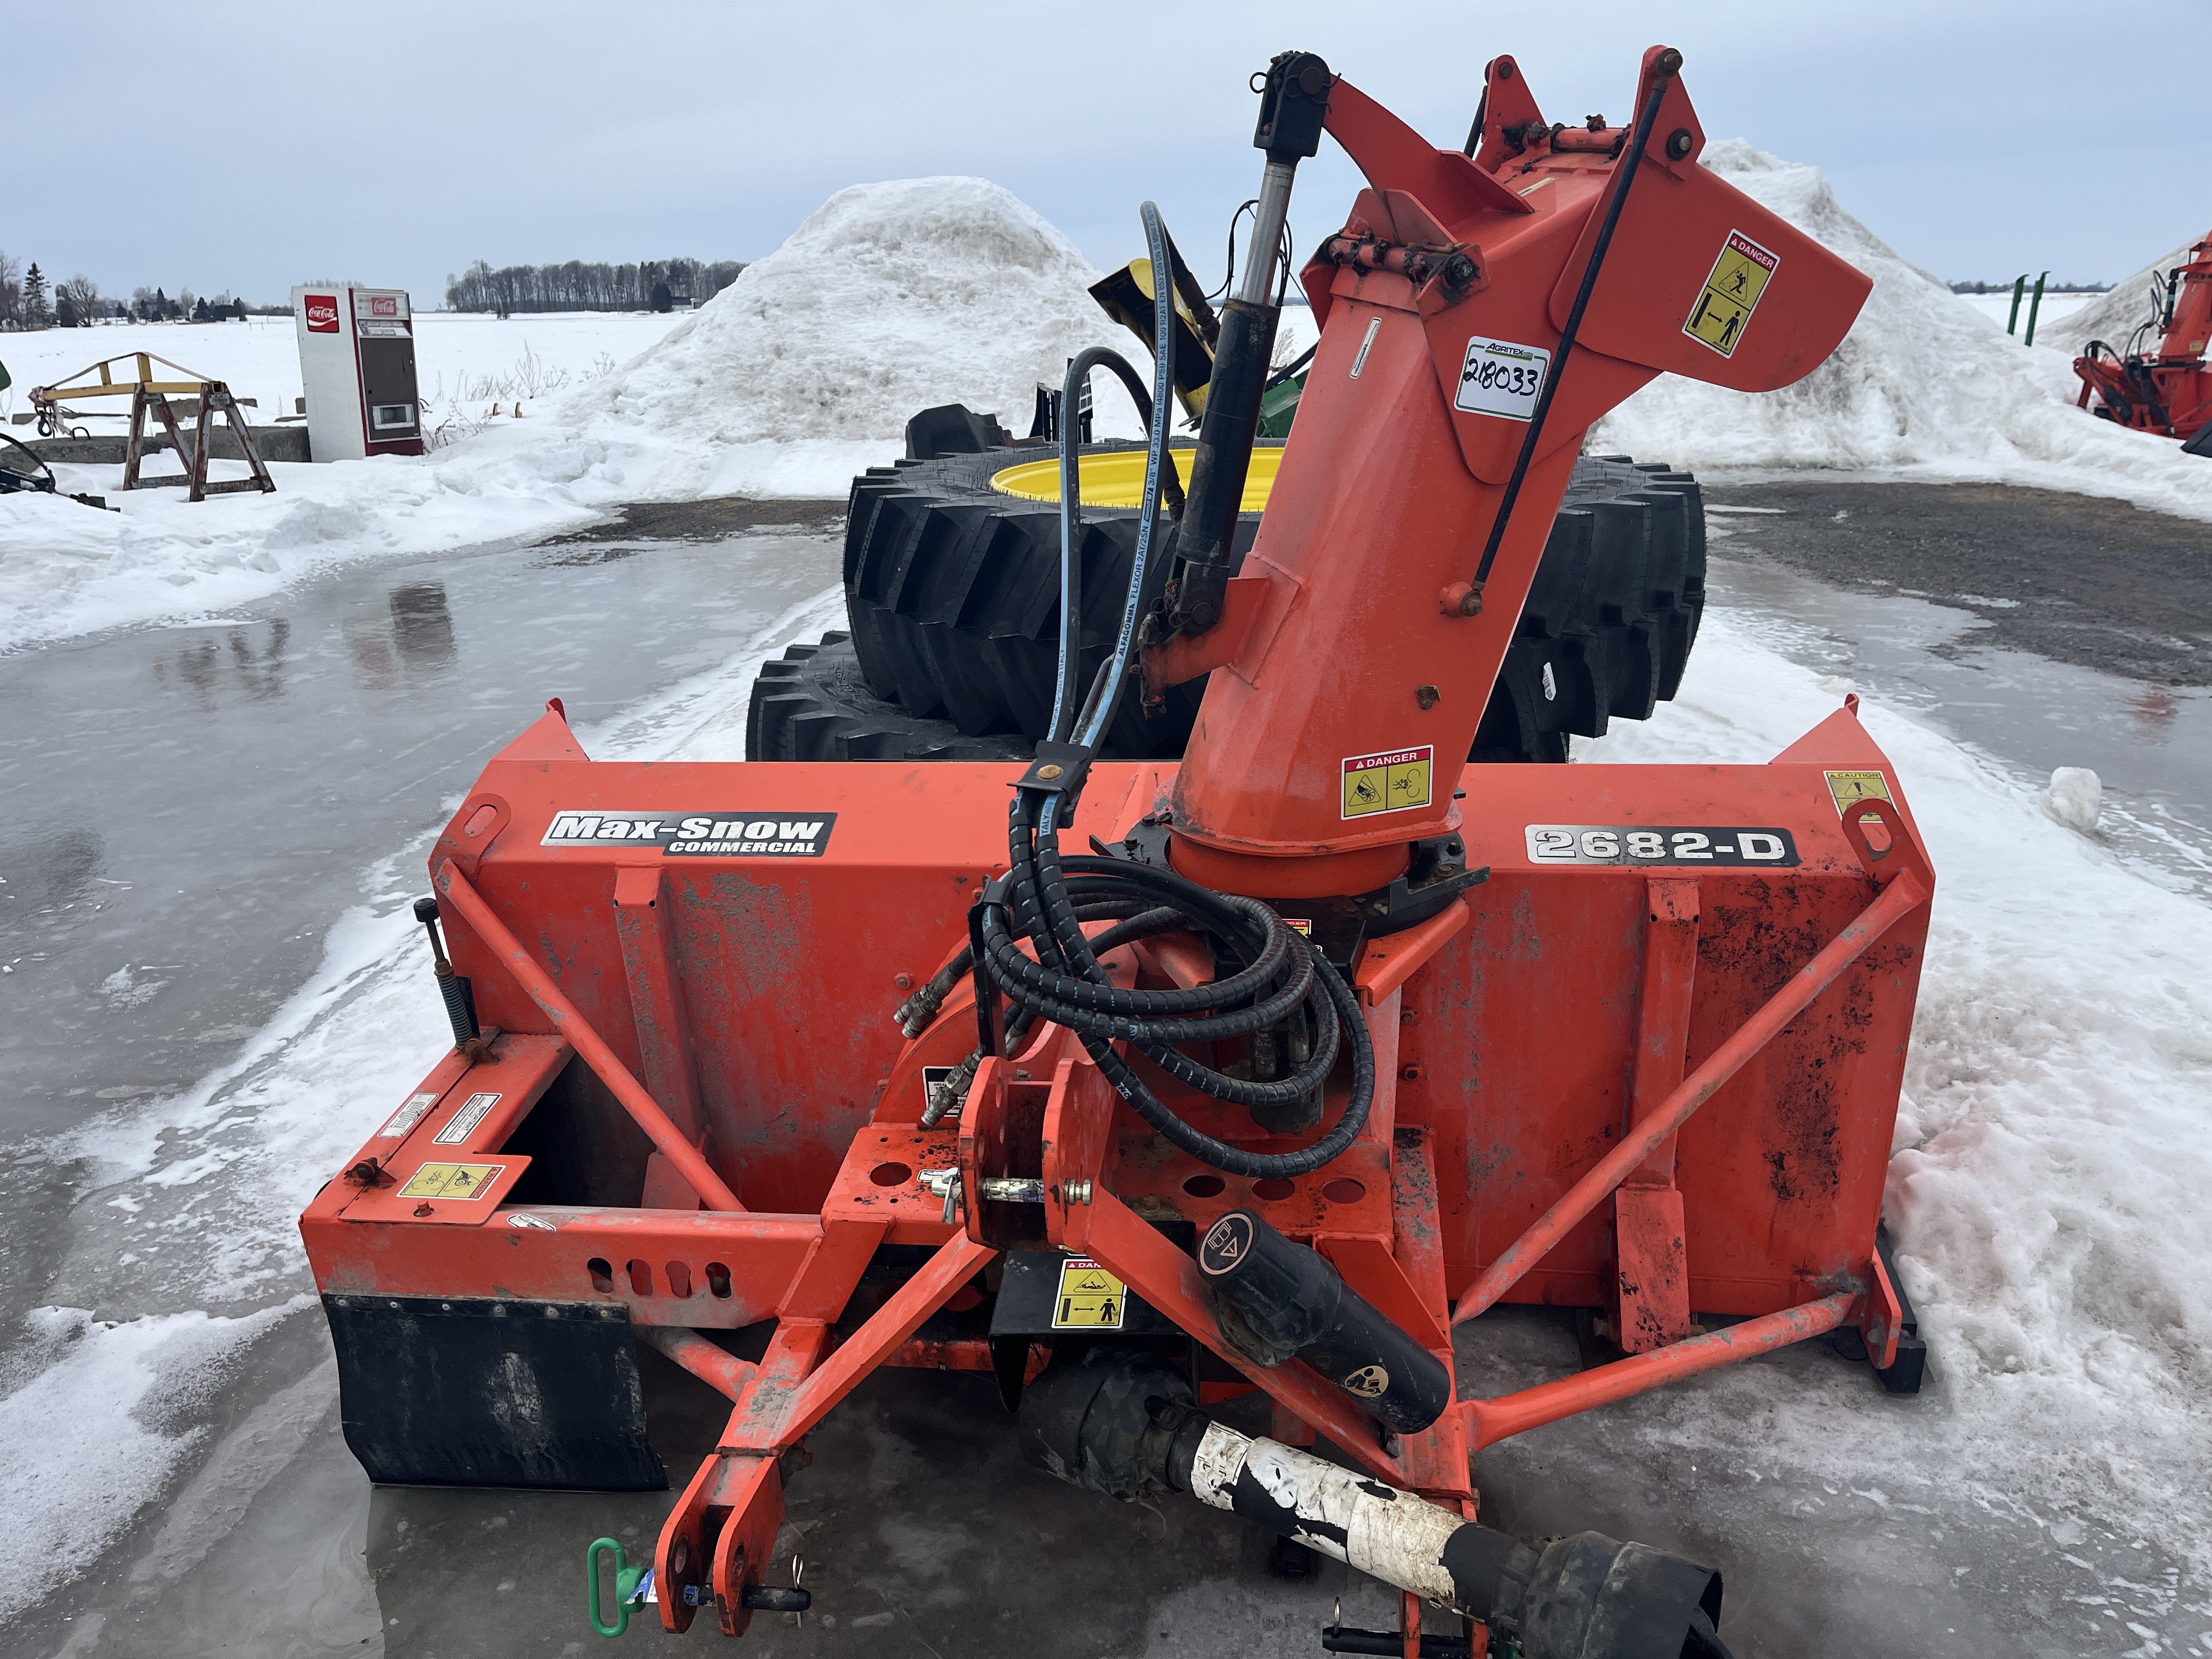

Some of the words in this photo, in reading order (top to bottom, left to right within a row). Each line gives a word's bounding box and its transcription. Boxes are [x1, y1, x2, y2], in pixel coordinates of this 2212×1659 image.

[1155, 251, 1162, 262] DN
[1738, 241, 1774, 268] DANGER
[1159, 292, 1166, 302] EN
[1486, 343, 1525, 356] AGRITEX
[1462, 358, 1538, 396] 218033
[1154, 408, 1163, 427] MPa
[1152, 430, 1160, 448] 33.0
[1150, 450, 1158, 466] WP
[1148, 467, 1156, 486] 3/8"
[1137, 526, 1149, 562] 2AT/2SN
[1130, 564, 1143, 599] FLEXOR
[1120, 603, 1135, 657] ALFAGOMMA
[1367, 752, 1418, 768] DANGER
[548, 816, 825, 840] Max-Snow
[668, 842, 816, 853] COMMERCIAL
[1535, 830, 1786, 860] 2682-D
[463, 1106, 487, 1131] IMPORTANT
[472, 1173, 495, 1198] WARNING
